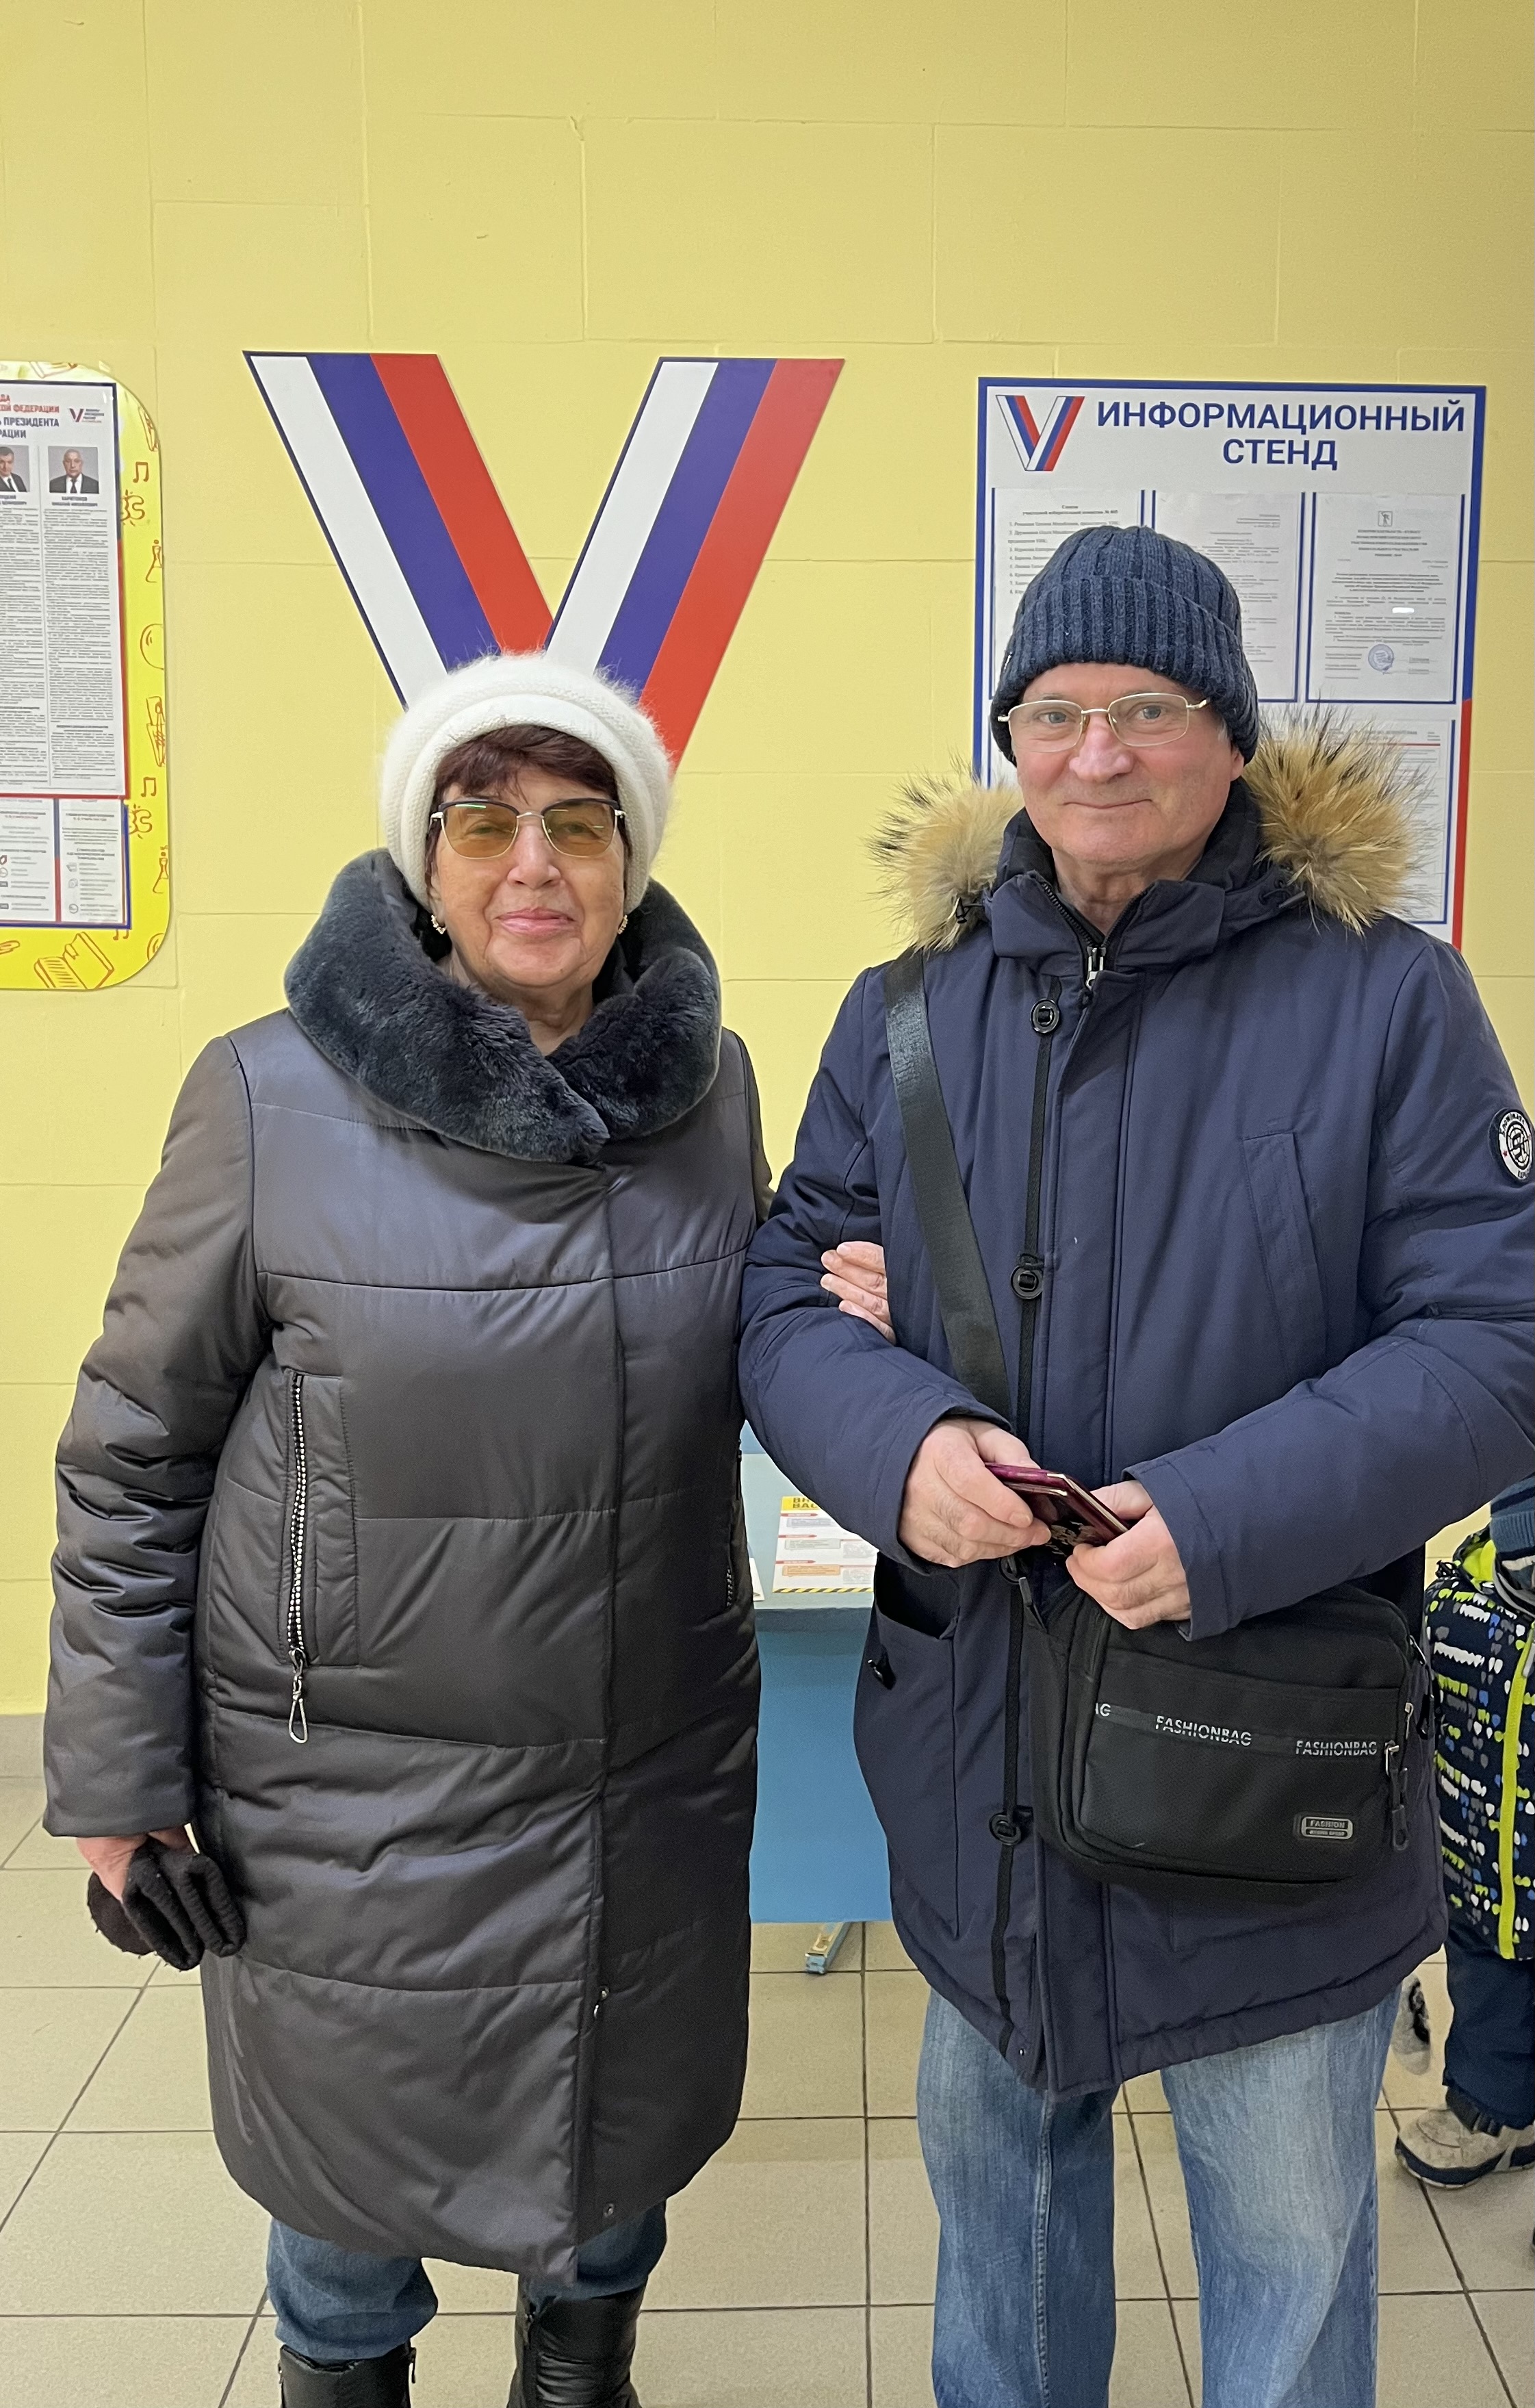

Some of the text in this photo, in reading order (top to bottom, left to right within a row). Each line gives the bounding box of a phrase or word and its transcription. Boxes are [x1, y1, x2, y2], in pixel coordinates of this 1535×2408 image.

[3, 416, 60, 427] ПРЕЗИДЕНТА
[1097, 399, 1464, 435] ИНФОРМАЦИОННЫЙ
[1222, 438, 1338, 470] СТЕНД
[1155, 1715, 1252, 1746] FASHIONBAG
[1295, 1741, 1378, 1756] FASHIONBAG
